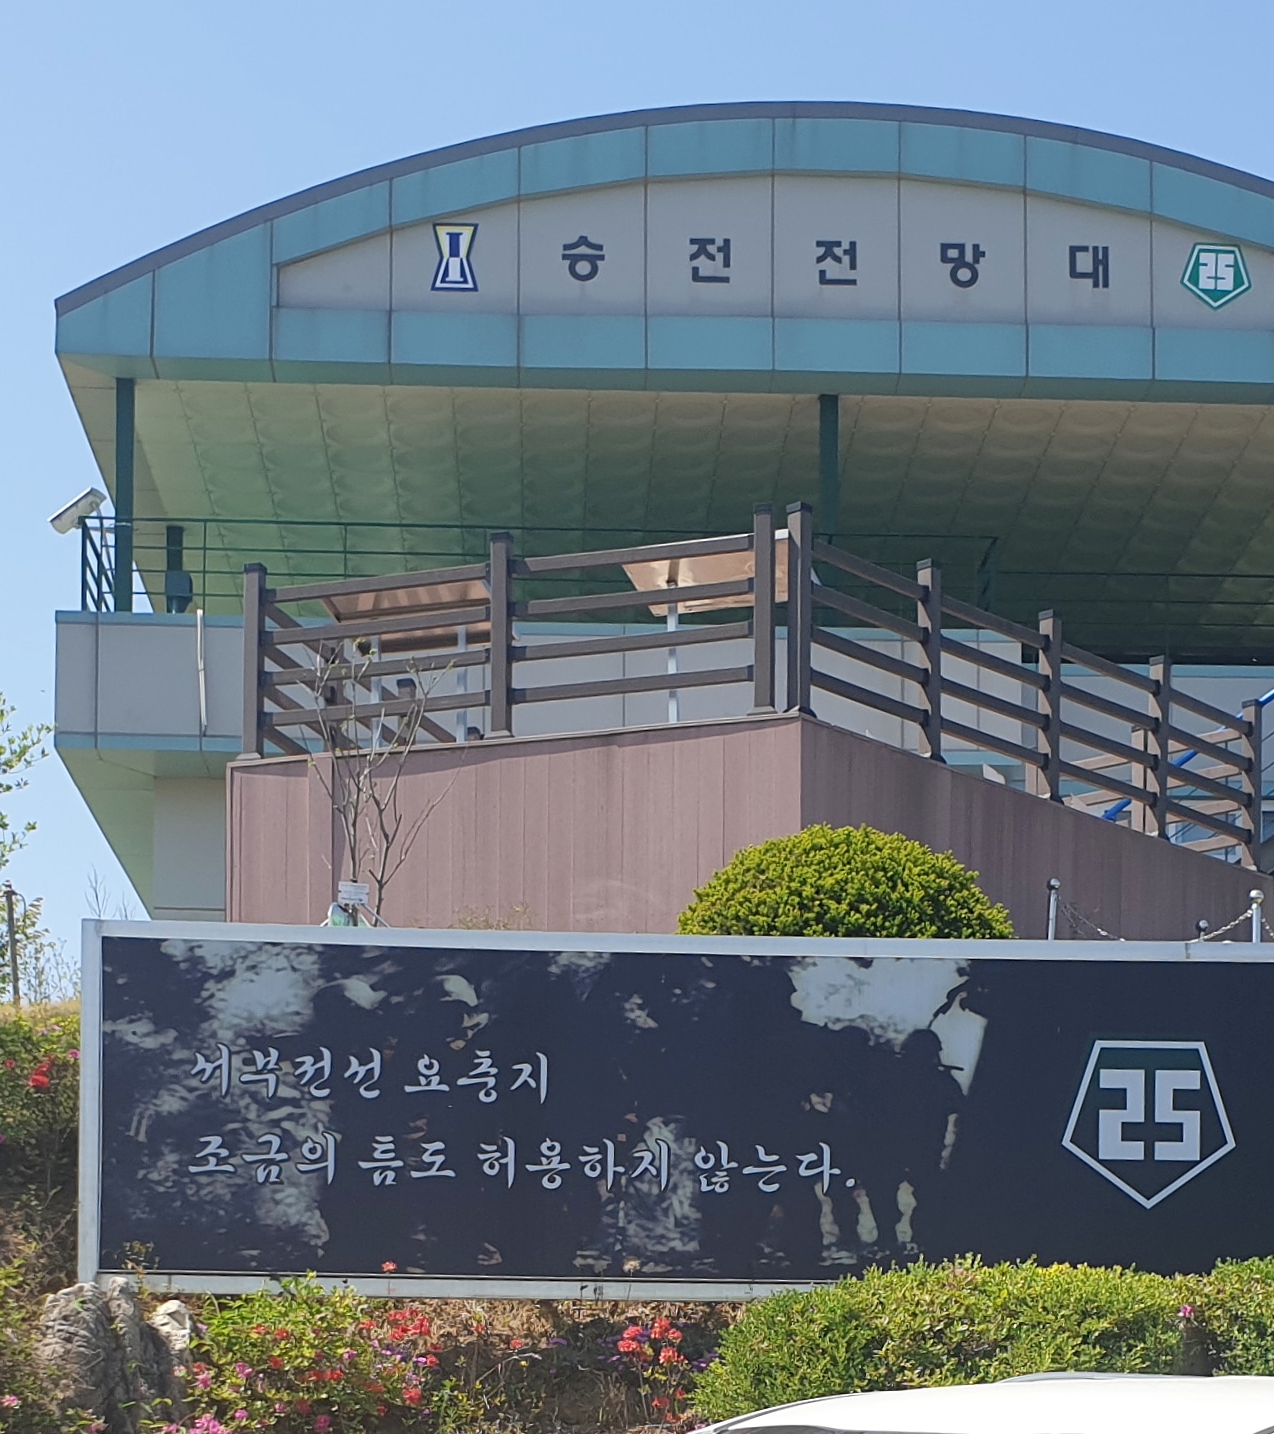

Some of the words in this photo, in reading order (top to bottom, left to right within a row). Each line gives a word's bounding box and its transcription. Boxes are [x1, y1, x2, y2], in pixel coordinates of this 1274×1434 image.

[561, 235, 1110, 289] 승전전망대
[1198, 252, 1235, 291] 25
[190, 1042, 383, 1100] 서부전선
[404, 1049, 549, 1104] 요충지
[1098, 1069, 1201, 1161] 25
[188, 1131, 337, 1185] 조금의
[358, 1135, 457, 1186] 틈도
[476, 1136, 672, 1191] 허용하지
[694, 1139, 856, 1195] 않는다.
